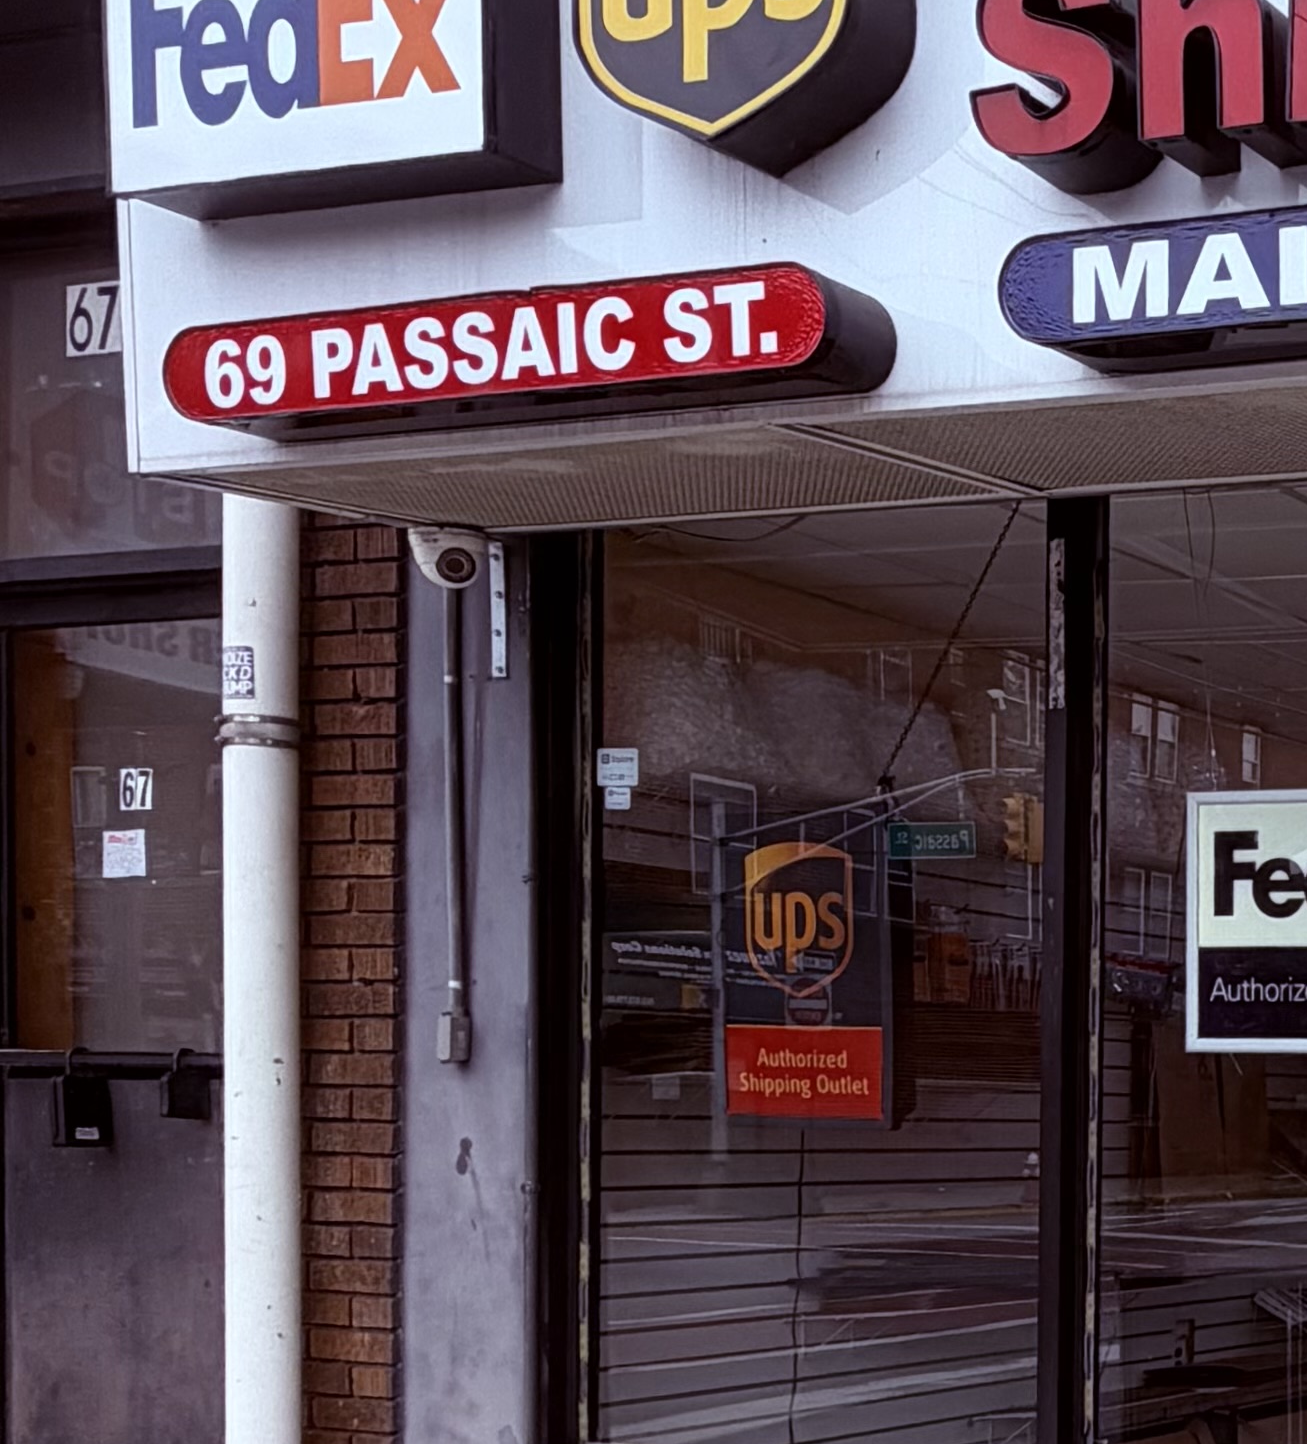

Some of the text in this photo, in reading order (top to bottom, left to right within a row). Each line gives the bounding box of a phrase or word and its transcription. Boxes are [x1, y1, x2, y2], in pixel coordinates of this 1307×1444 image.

[69, 285, 119, 354] 67
[204, 281, 779, 409] 69 PASSAIC ST.
[122, 771, 151, 808] 67
[755, 891, 846, 973] ups
[757, 1047, 848, 1070] Authorized
[740, 1073, 869, 1098] Shipping Outlet
